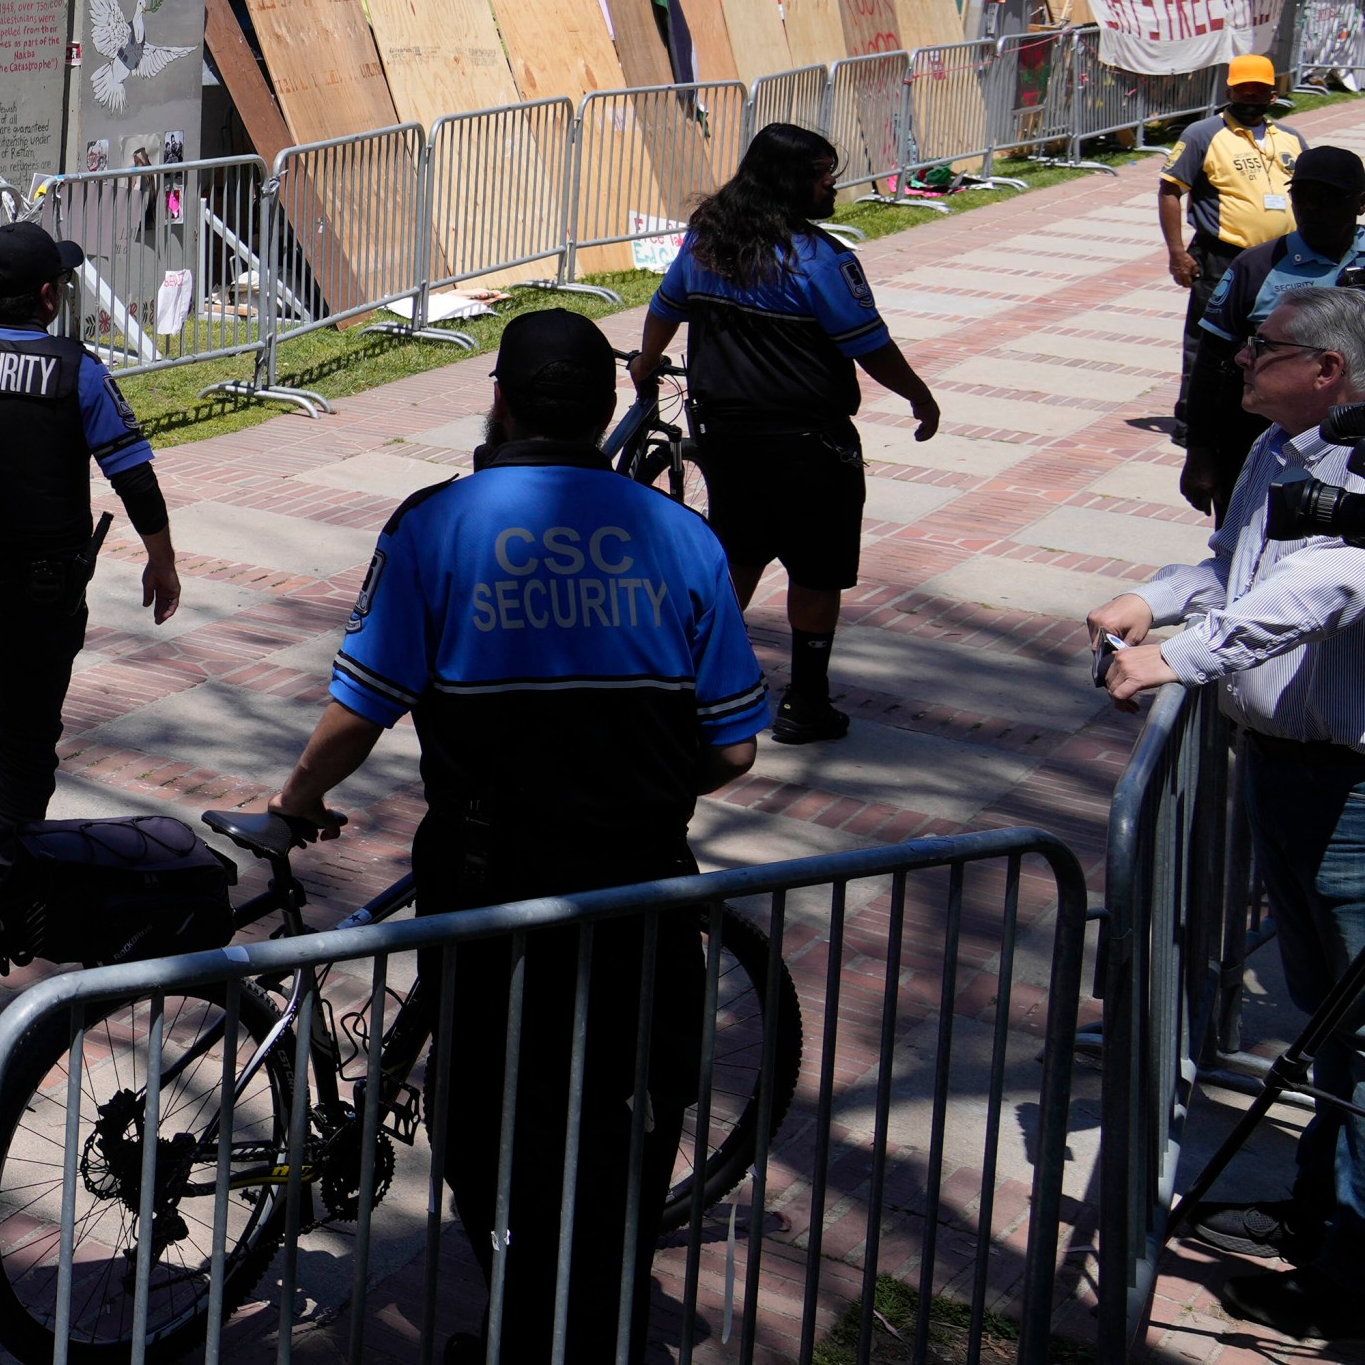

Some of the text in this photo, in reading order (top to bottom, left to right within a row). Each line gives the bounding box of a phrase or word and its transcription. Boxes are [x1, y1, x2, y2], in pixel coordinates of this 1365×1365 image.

[18, 2, 34, 12] over
[38, 13, 56, 23] were
[23, 27, 40, 35] from
[40, 25, 57, 34] their
[23, 39, 39, 49] part
[38, 37, 47, 47] of
[48, 36, 60, 46] the
[13, 50, 36, 60] Nakba
[0, 114, 8, 123] of
[9, 114, 18, 124] all
[0, 126, 11, 134] are
[13, 119, 50, 138] guaranteed
[30, 134, 52, 145] under
[10, 159, 52, 172] refugees are
[1233, 157, 1262, 171] 5155
[633, 242, 657, 264] End
[1274, 281, 1315, 293] SECURITY
[495, 525, 635, 577] CSC
[472, 577, 669, 633] SECURITY
